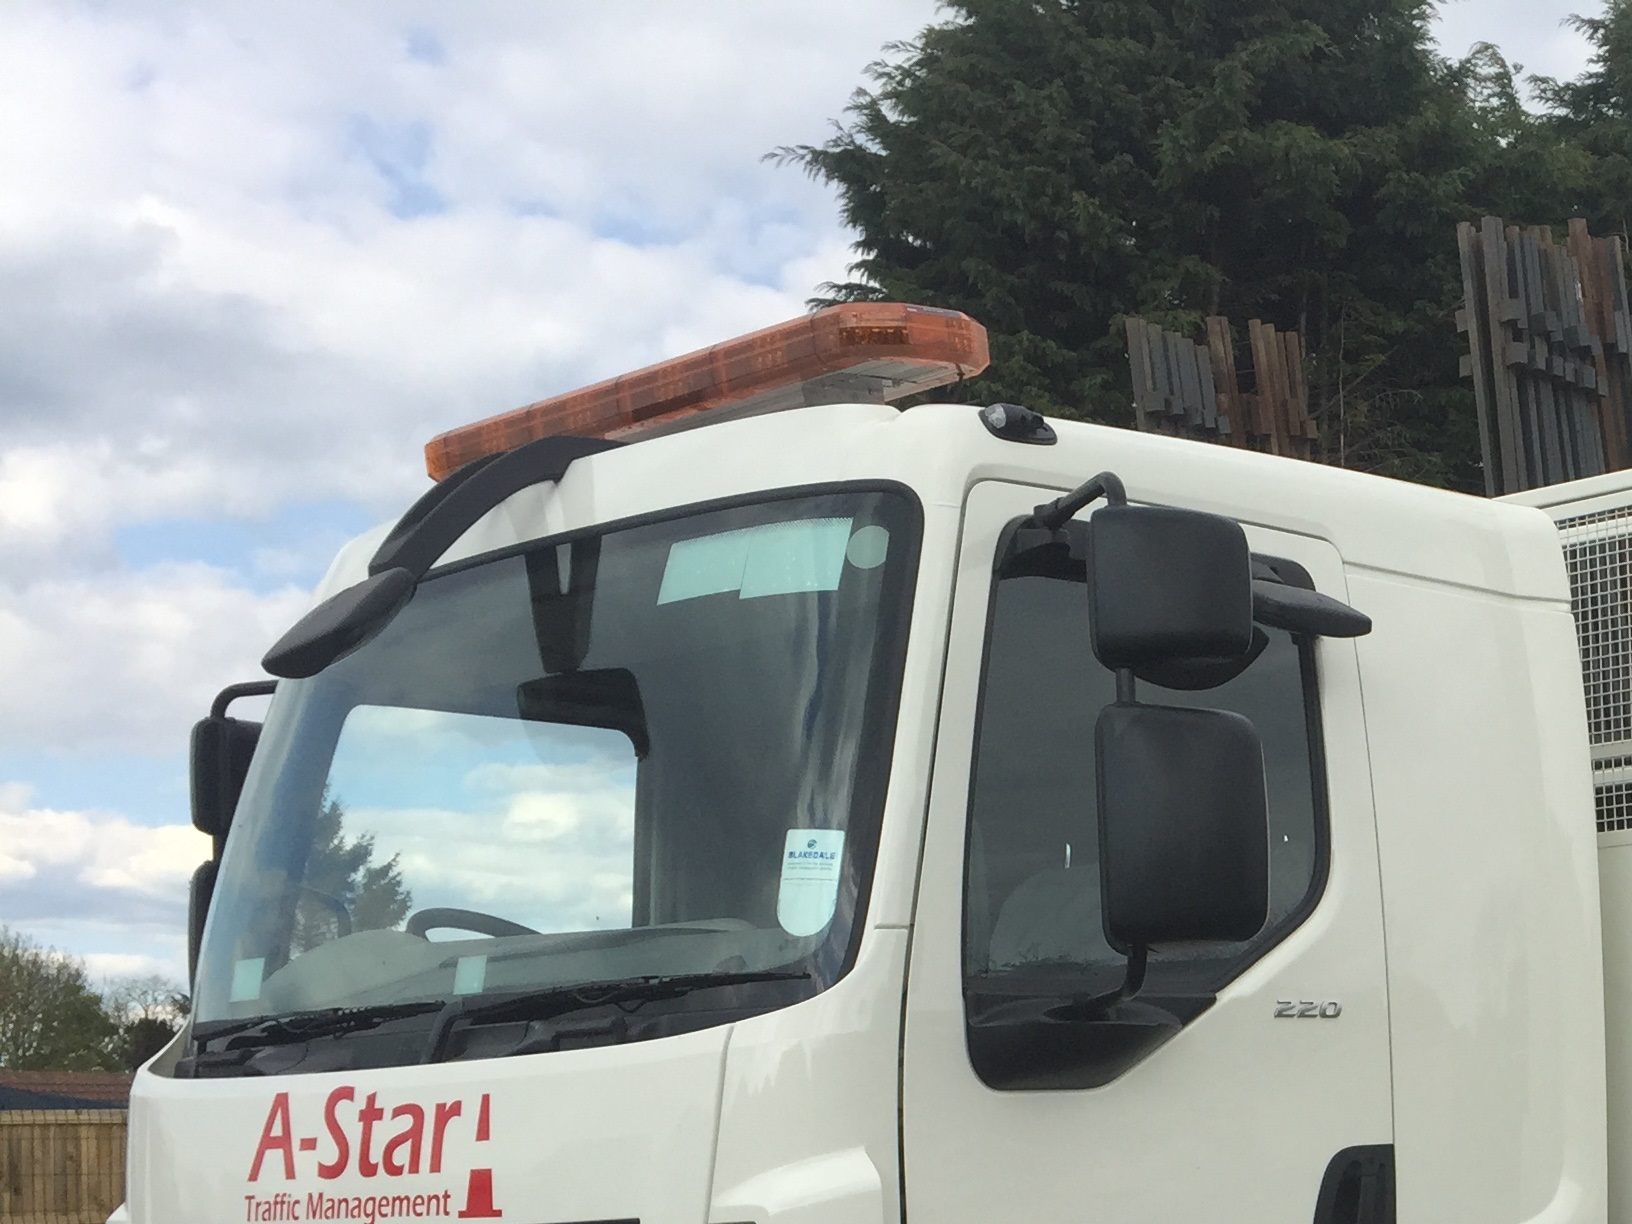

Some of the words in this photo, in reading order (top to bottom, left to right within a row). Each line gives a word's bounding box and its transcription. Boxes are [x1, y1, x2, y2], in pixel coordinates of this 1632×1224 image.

[1274, 1000, 1342, 1018] 220
[247, 1085, 462, 1182] A-Star
[244, 1192, 301, 1222] Traffic
